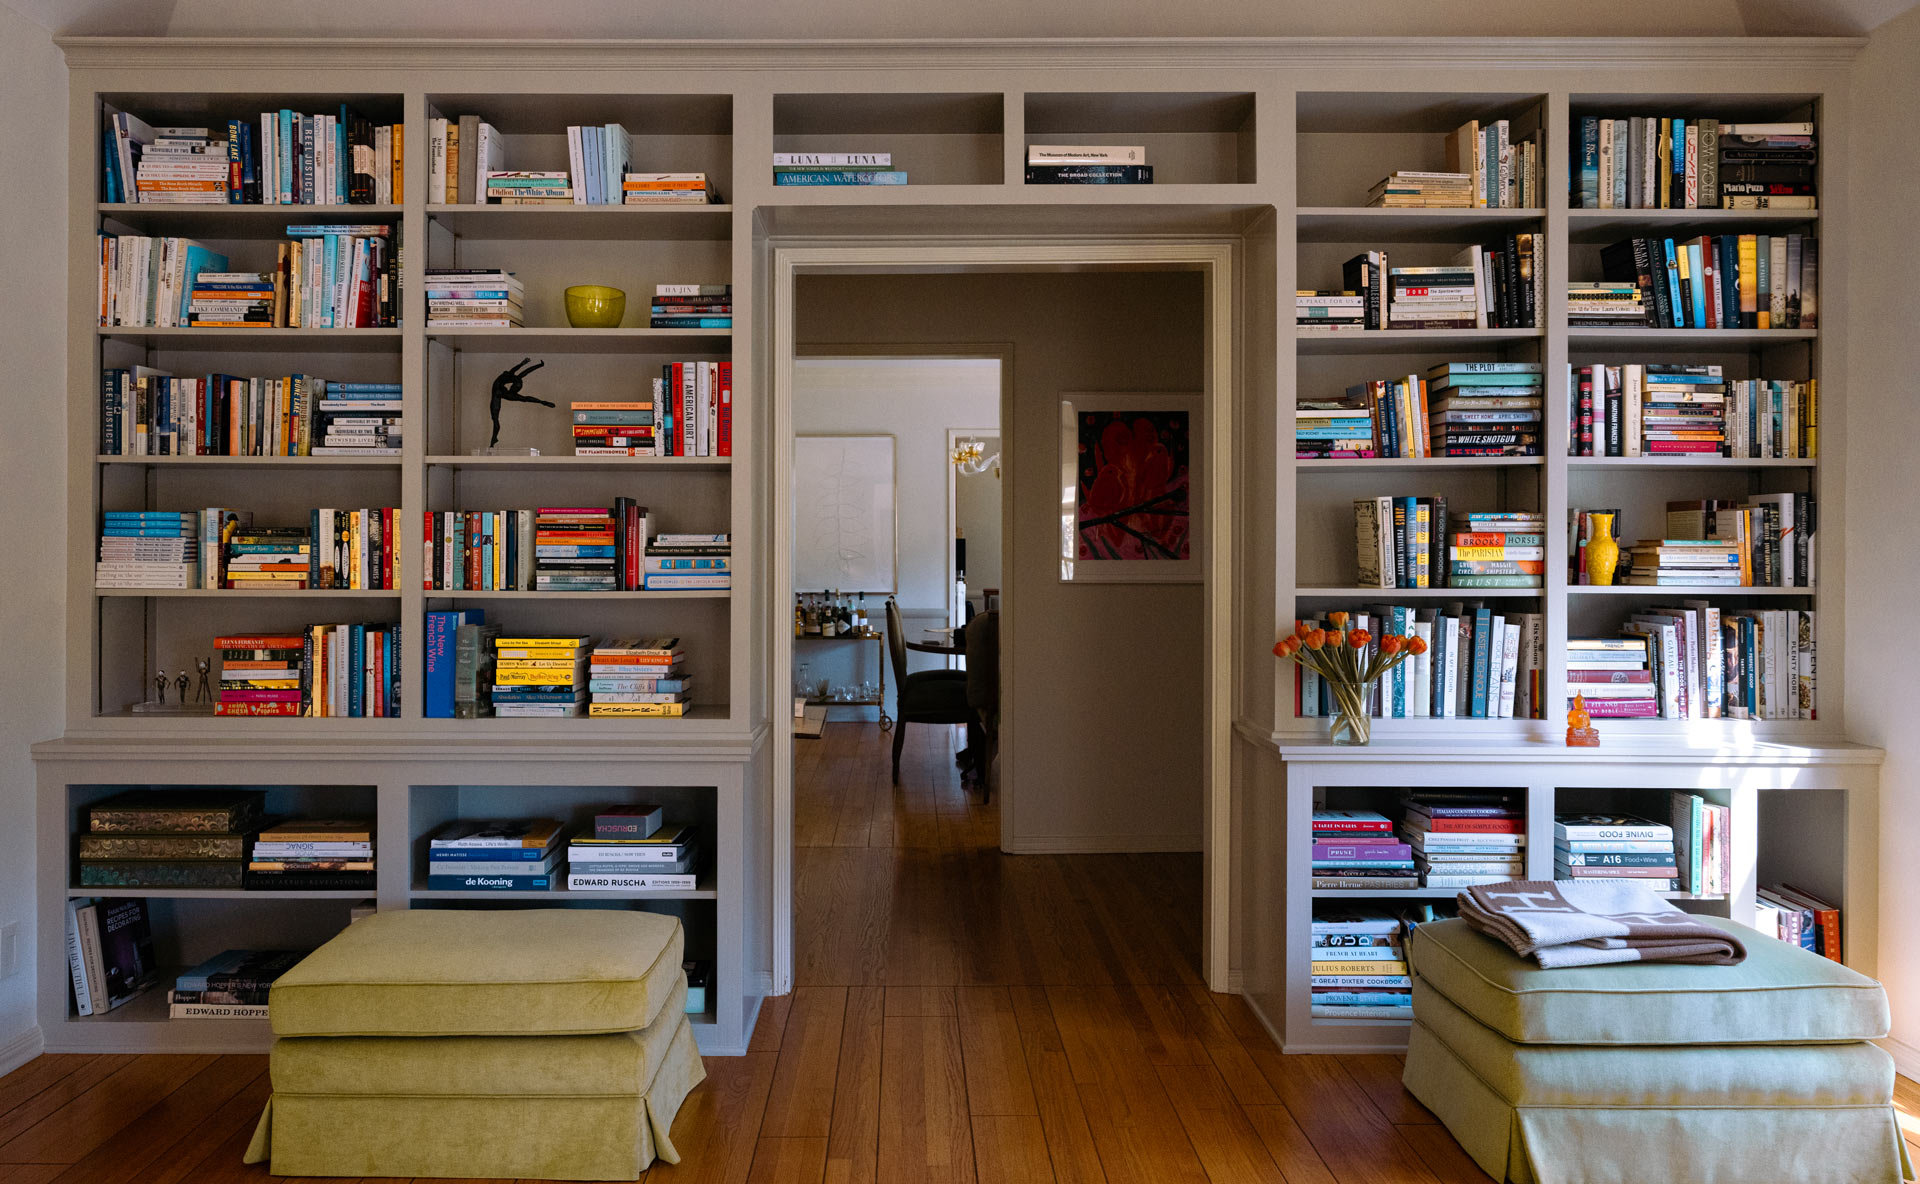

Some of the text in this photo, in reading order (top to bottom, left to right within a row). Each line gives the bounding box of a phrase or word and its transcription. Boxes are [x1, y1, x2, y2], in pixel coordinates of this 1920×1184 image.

[229, 125, 239, 160] BONE LAKE
[1702, 128, 1715, 158] TOM
[304, 129, 313, 193] REEL JUSTICE
[790, 155, 877, 164] LUNA LUNA
[782, 174, 829, 184] AMERICAN
[1723, 184, 1745, 194] Mario
[1638, 238, 1648, 268] SALMAN
[1465, 363, 1496, 372] THE PLOT
[723, 368, 731, 386] DIRT
[105, 381, 113, 444] REEL JUSTICE
[293, 397, 301, 414] LAKE
[685, 384, 694, 440] AMERICAN DIRT
[1457, 435, 1517, 444] WHITE SHOTGUN
[1395, 507, 1405, 526] JAMES
[1463, 538, 1500, 546] BROOKS
[1508, 536, 1536, 544] HORSE
[1459, 548, 1503, 558] The PARISIAN
[428, 615, 437, 672] French Wine
[437, 615, 446, 657] The New
[1476, 630, 1487, 651] TASTE
[1765, 647, 1775, 687] SWEET
[1474, 656, 1485, 699] TECHNIQUE
[1488, 661, 1500, 702] BEANS
[1599, 830, 1654, 838] DIVINE FOOD
[1602, 855, 1622, 864] A16
[465, 877, 513, 888] de Kooning
[573, 878, 646, 887] EDWARD RUSCHA
[1315, 880, 1339, 888] Pierre
[106, 907, 141, 926] RECIPES FOR
[185, 1008, 231, 1016] EDWARD
